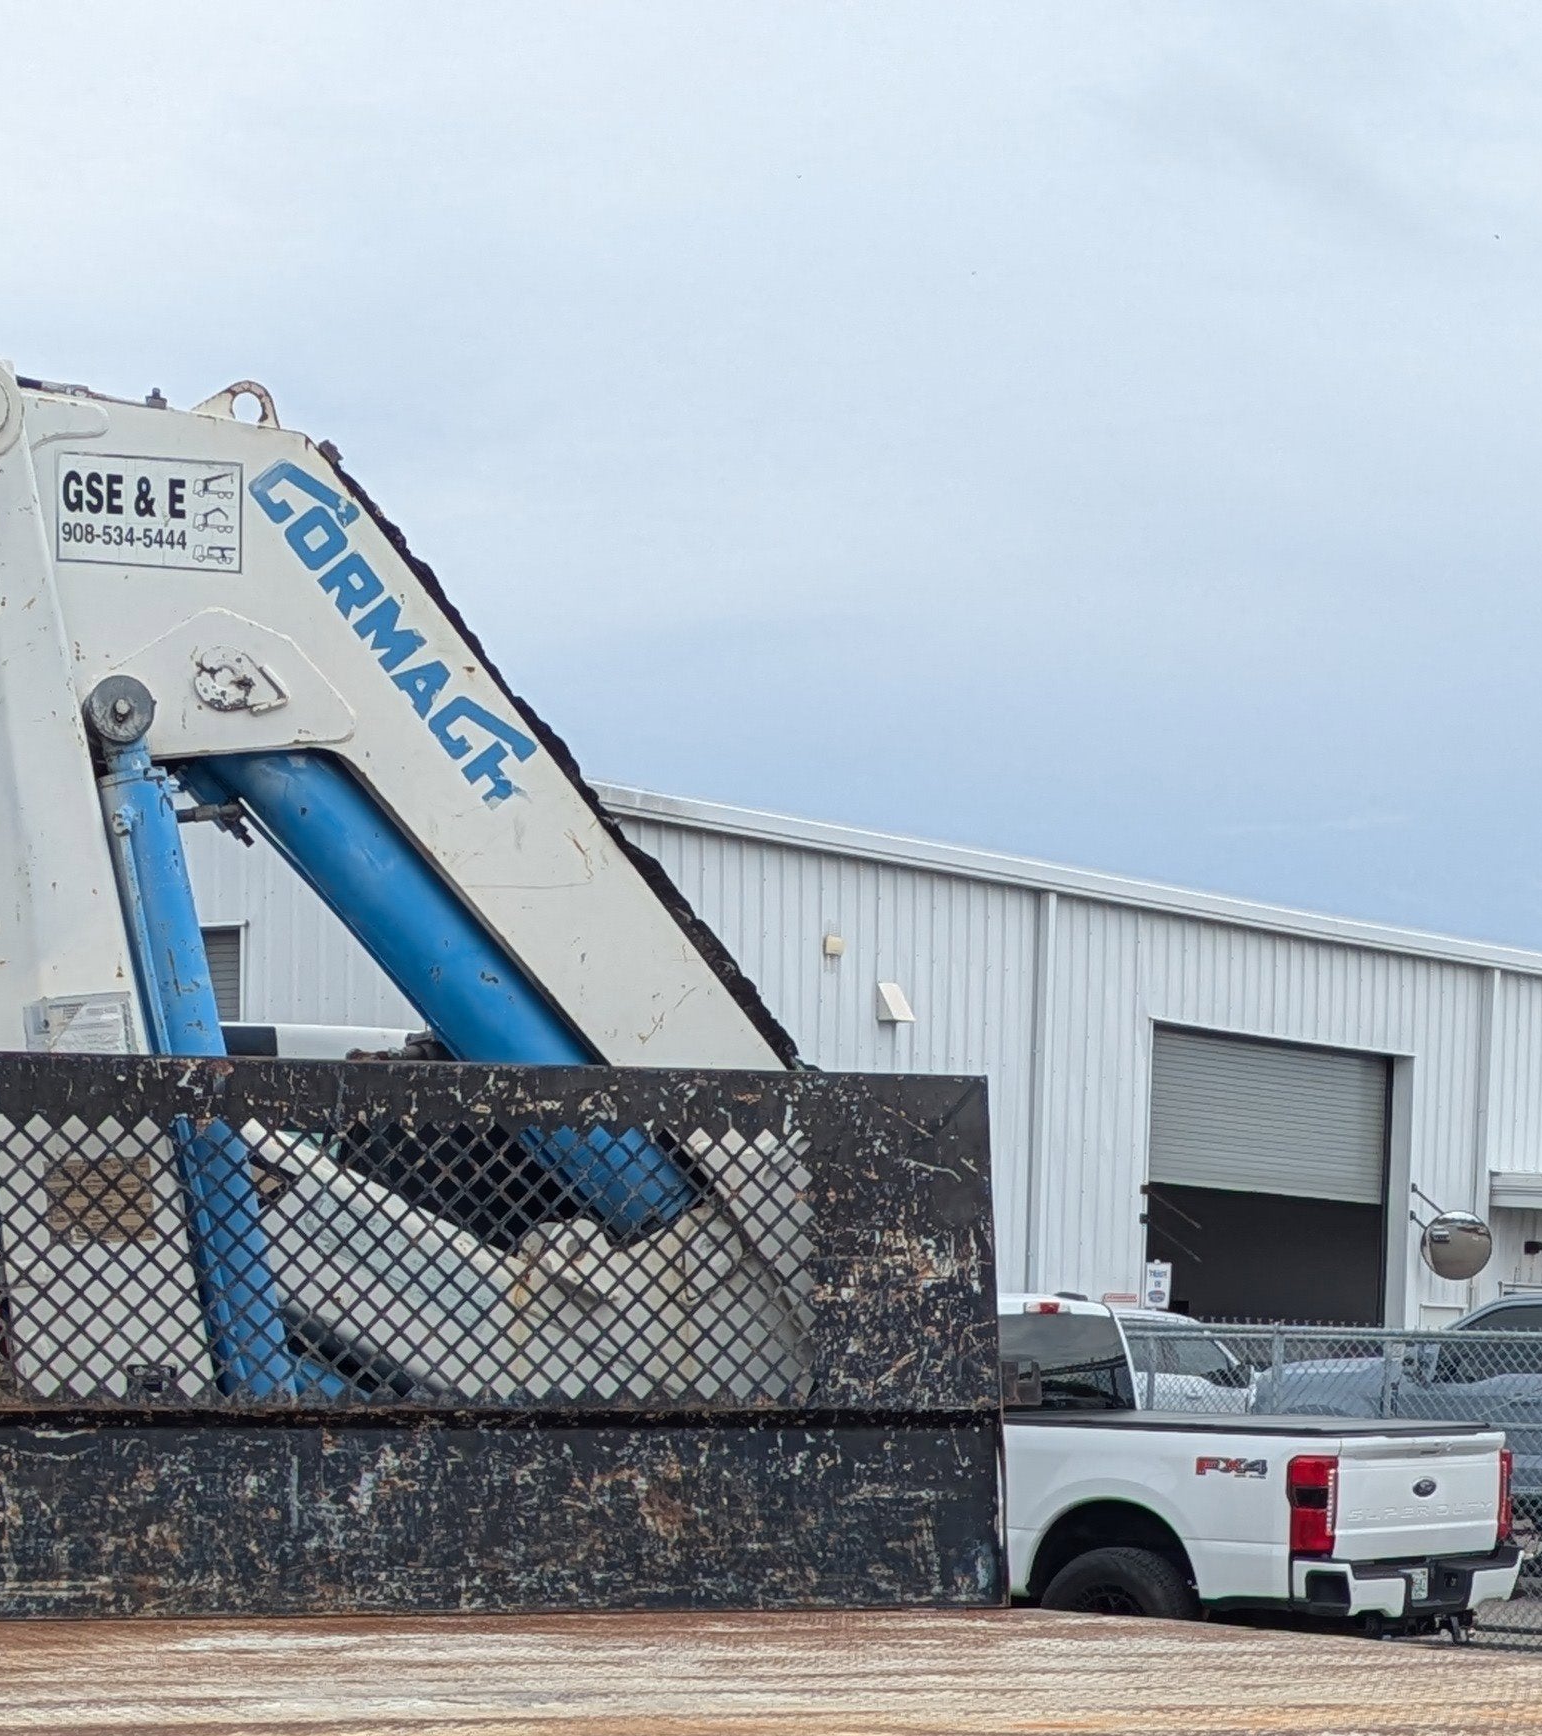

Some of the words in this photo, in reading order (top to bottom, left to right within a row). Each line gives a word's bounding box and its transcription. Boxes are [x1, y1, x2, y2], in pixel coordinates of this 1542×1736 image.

[62, 470, 123, 515] GSE
[134, 476, 156, 518] &
[168, 478, 186, 519] E
[61, 522, 187, 550] 908-534-5444
[1195, 1456, 1268, 1475] FX4
